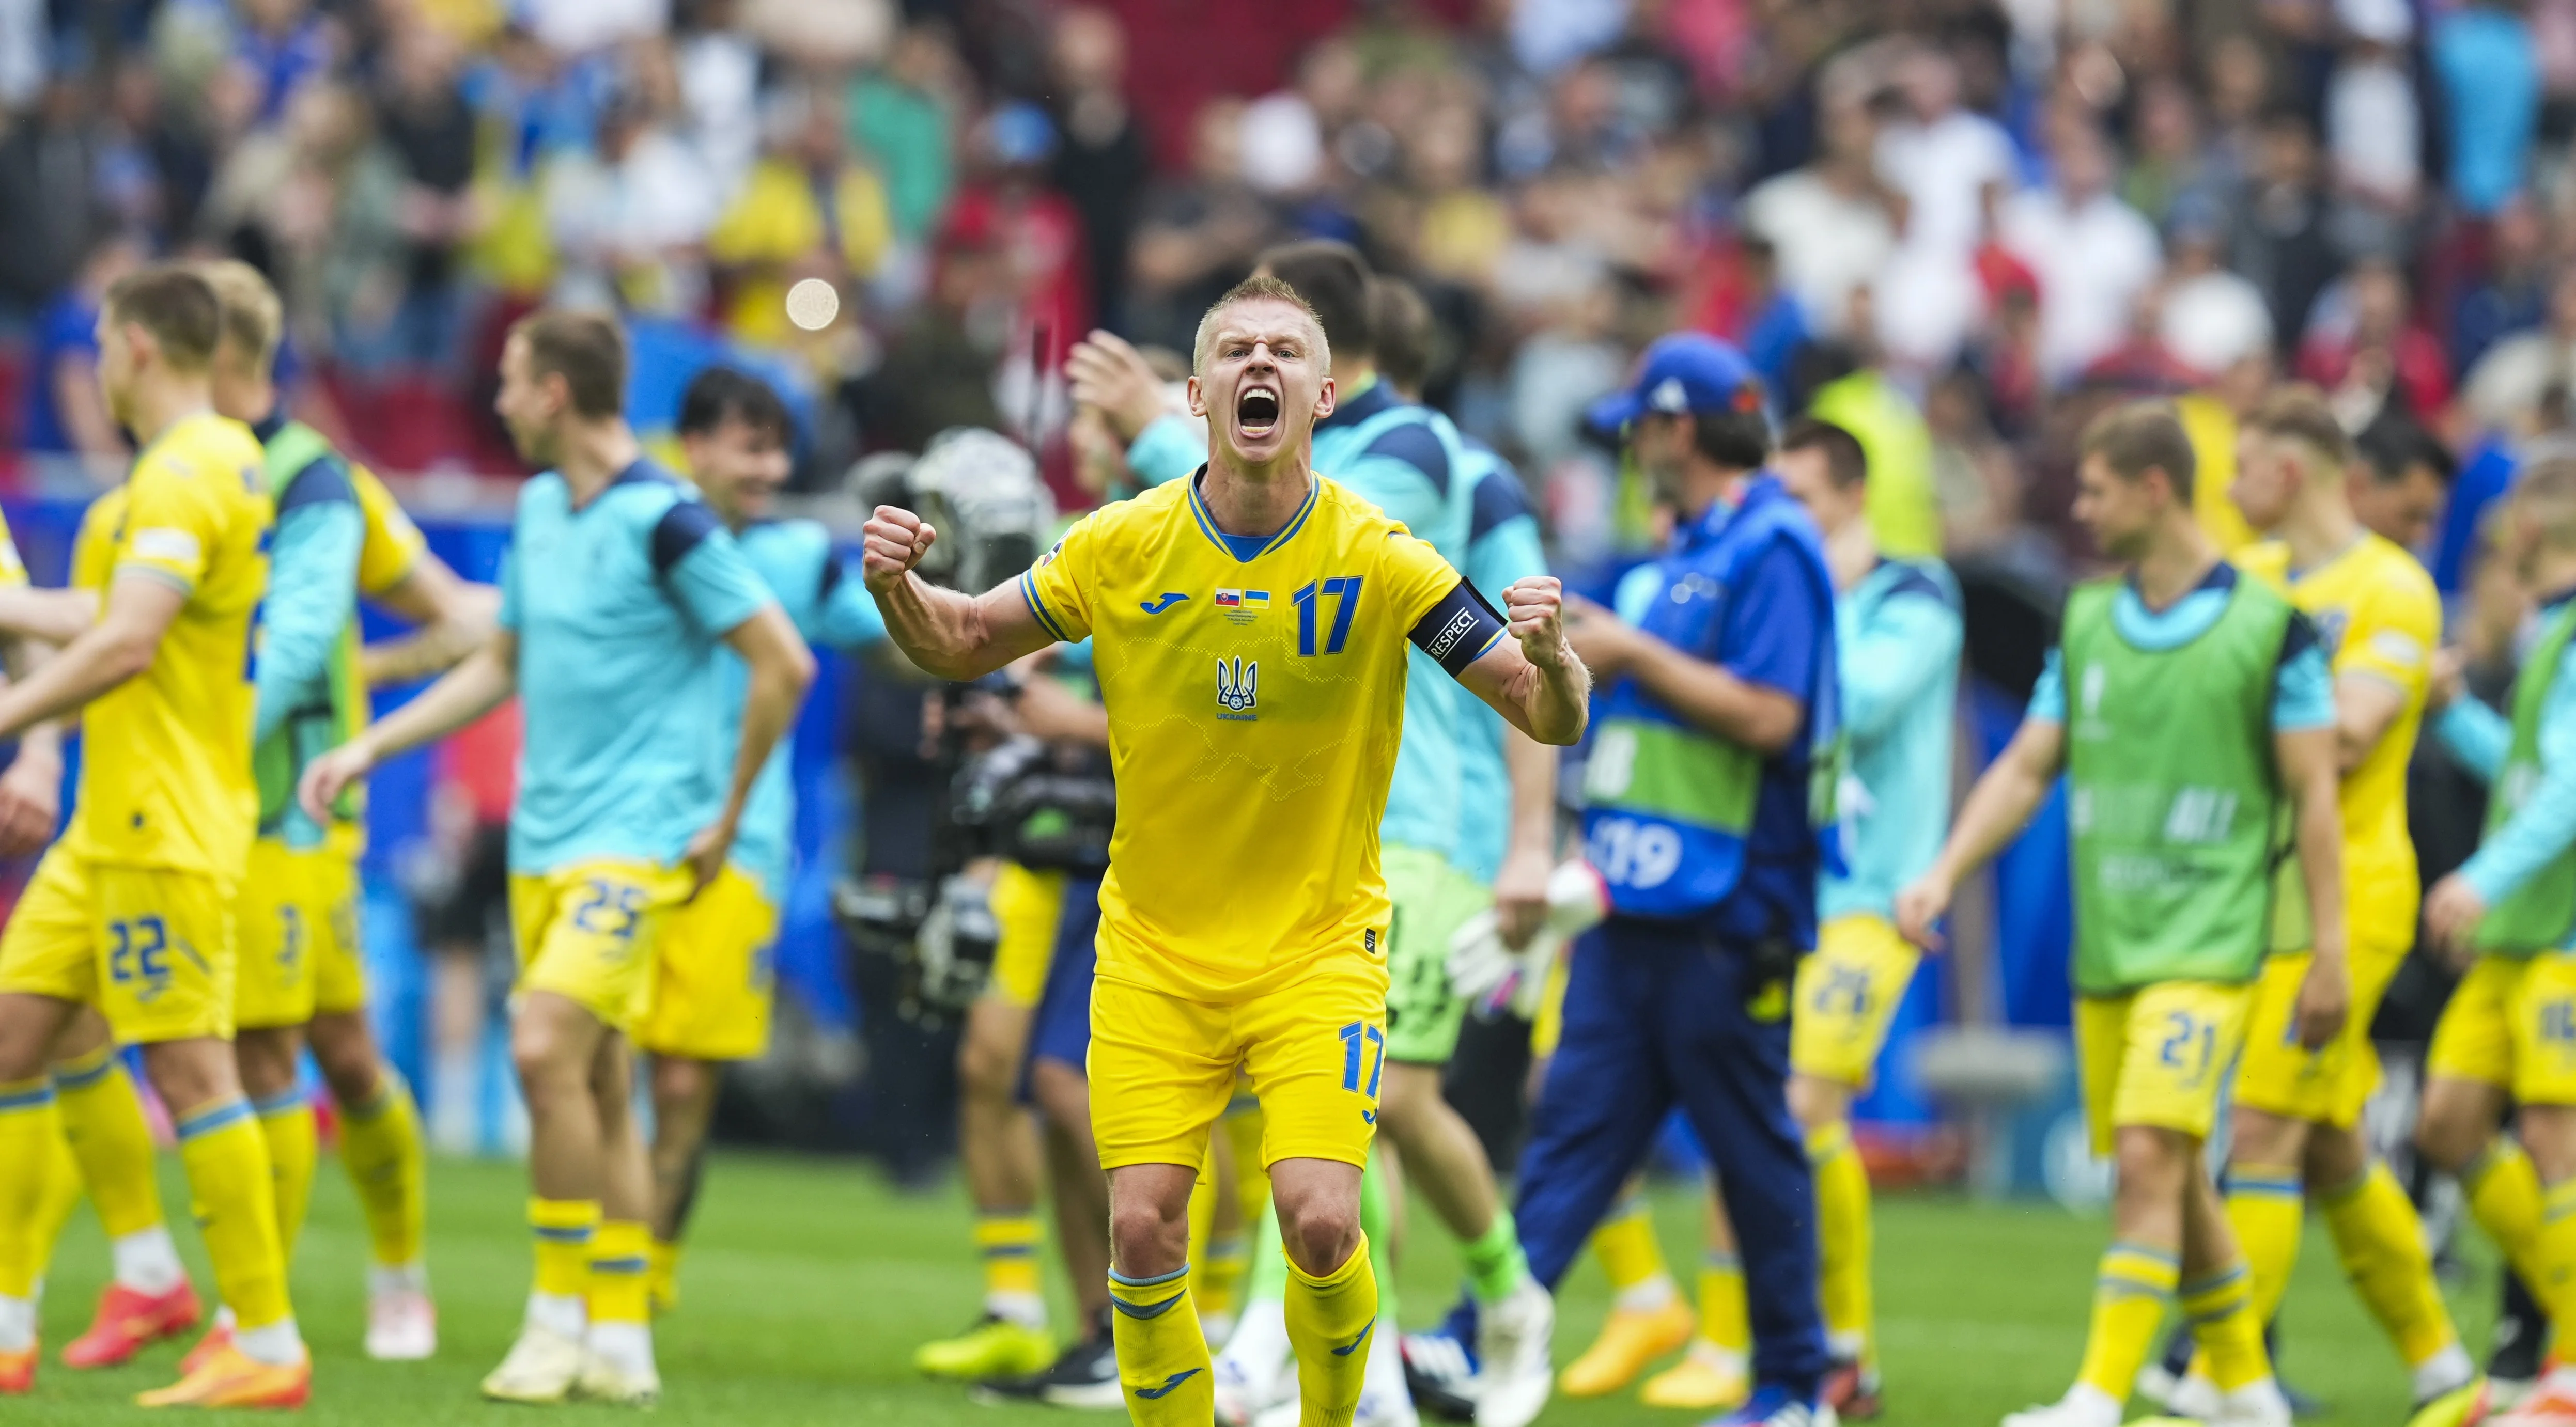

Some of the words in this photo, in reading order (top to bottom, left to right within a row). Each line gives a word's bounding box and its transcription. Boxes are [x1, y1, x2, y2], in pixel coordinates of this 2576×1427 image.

[1291, 575, 1363, 656] 17
[1431, 610, 1474, 658] RESPECT
[1216, 713, 1258, 722] UKRAINE
[575, 879, 644, 939] 25
[110, 914, 170, 980] 22
[1339, 1020, 1384, 1100] 17
[2161, 1011, 2214, 1069] 21
